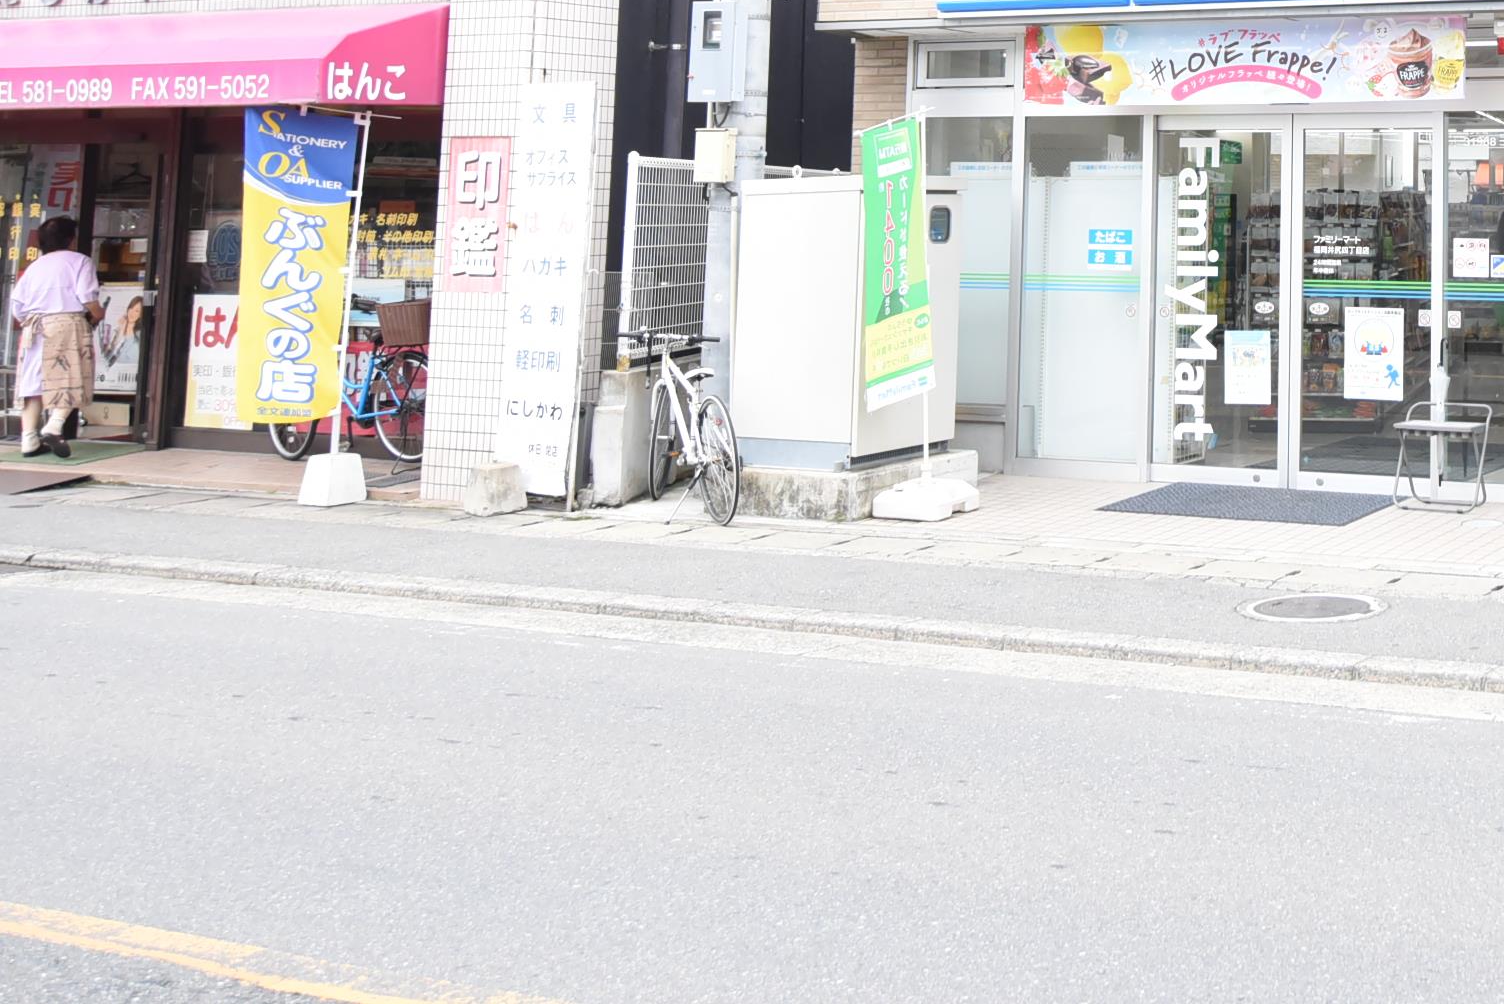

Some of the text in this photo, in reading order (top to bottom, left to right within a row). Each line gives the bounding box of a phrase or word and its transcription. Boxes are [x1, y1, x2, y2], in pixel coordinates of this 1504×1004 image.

[1149, 40, 1338, 86] #LOVE Frappe!
[23, 76, 113, 104] 581-0989
[131, 75, 168, 101] FAX
[174, 73, 271, 100] 591-5052
[326, 61, 407, 102] はんこ
[532, 102, 577, 124] 文具
[257, 151, 310, 179] OA
[282, 173, 344, 191] SUPPLIER
[452, 150, 502, 278] 印鑑
[1094, 230, 1127, 243] たばこ
[1312, 235, 1361, 245] ファミリーマート
[1164, 137, 1221, 442] FamilyMart
[256, 206, 326, 404] ぶんぐの店
[519, 304, 565, 327] 名刺
[515, 349, 562, 373] 軽印刷
[506, 399, 563, 421] にしかわ
